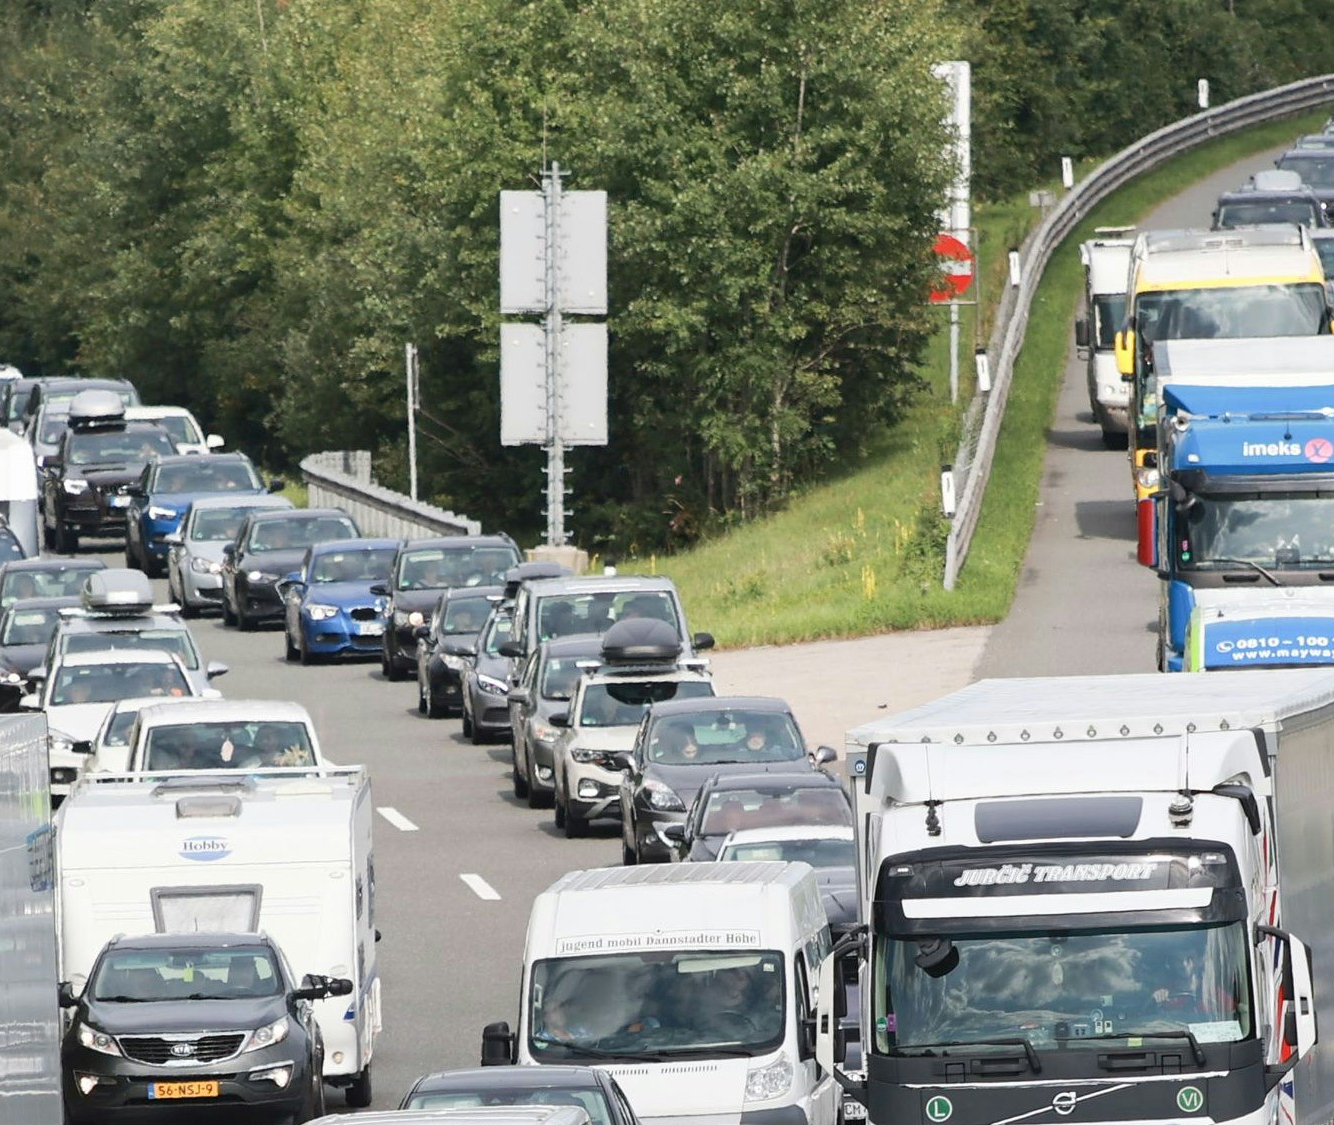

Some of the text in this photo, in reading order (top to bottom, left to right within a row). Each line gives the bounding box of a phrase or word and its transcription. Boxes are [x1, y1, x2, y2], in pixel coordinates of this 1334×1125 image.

[1243, 441, 1301, 456] imeks
[1236, 637, 1279, 649] 0810
[1296, 636, 1328, 646] 100
[183, 840, 229, 850] Hobby
[1033, 863, 1157, 882] TRANSPORT
[607, 937, 642, 948] mobil
[726, 932, 756, 944] Höhe
[1182, 1093, 1197, 1107] VI
[934, 1102, 945, 1117] L
